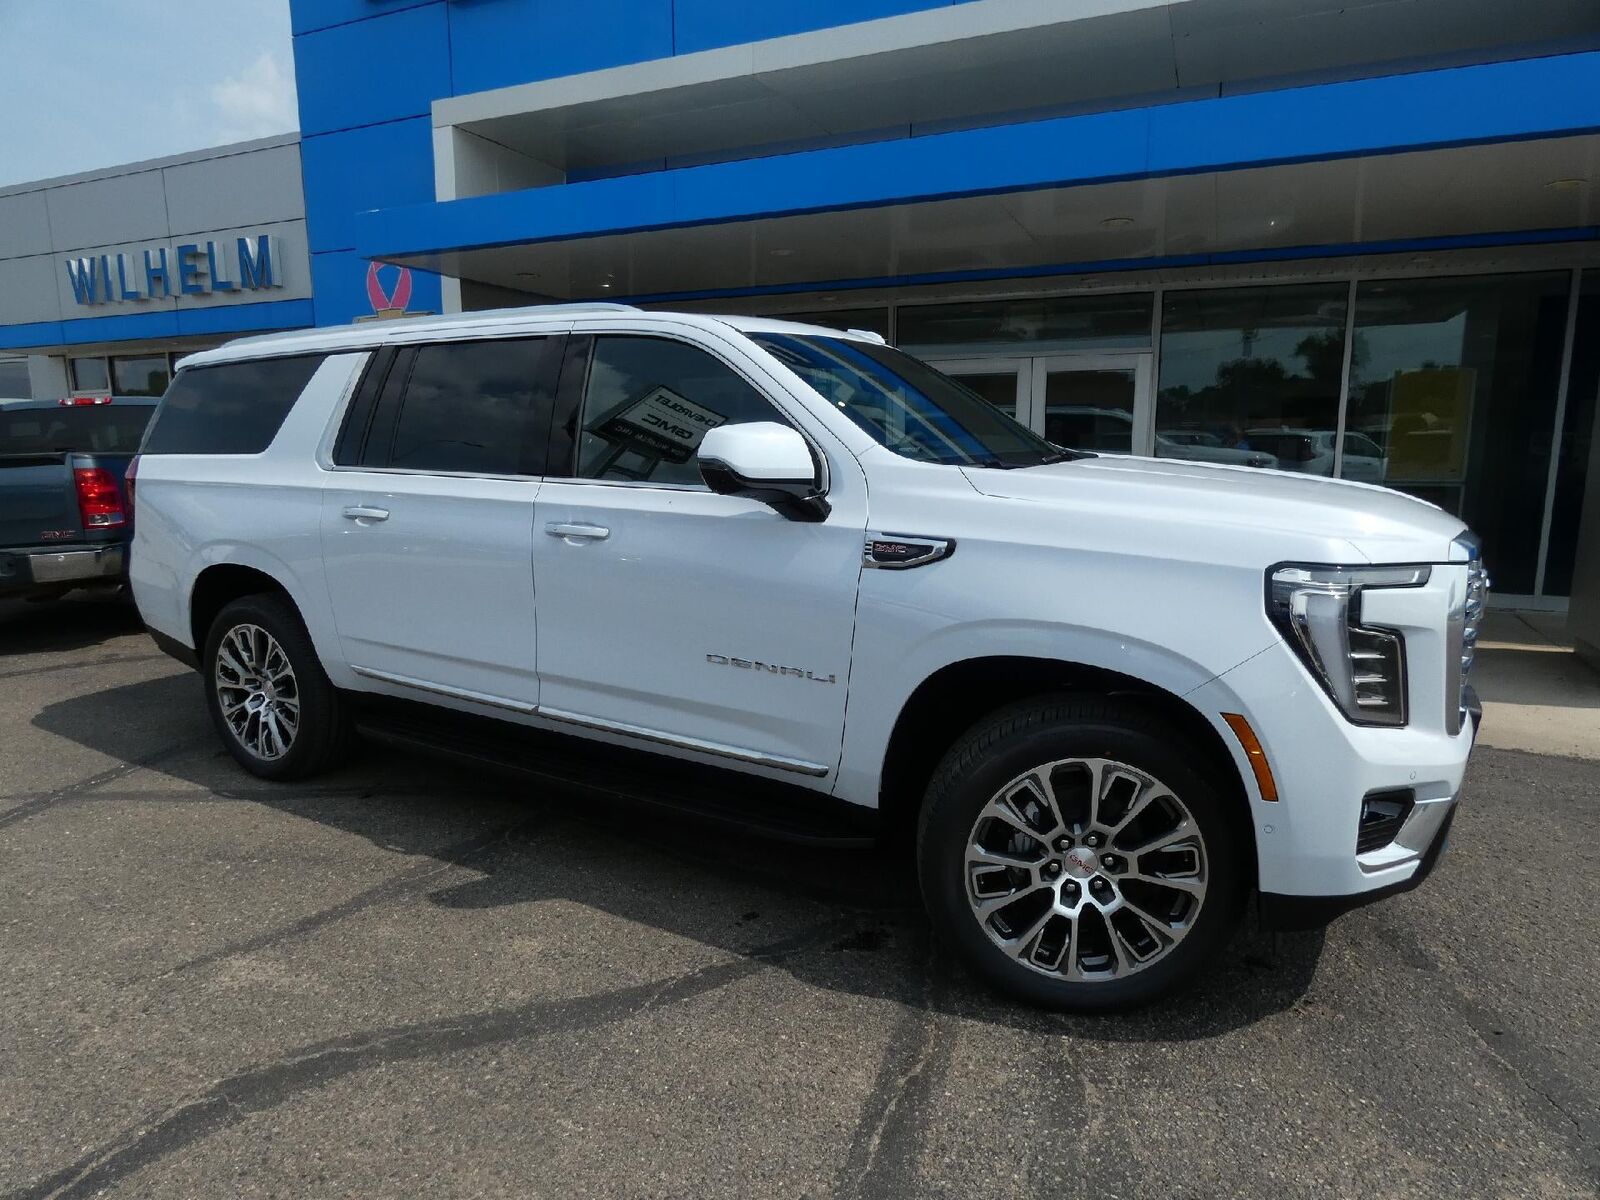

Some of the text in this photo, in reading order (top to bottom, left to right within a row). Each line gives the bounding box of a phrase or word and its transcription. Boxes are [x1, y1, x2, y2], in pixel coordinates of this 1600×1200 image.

[65, 235, 275, 305] WILHELM
[874, 543, 907, 553] GMC
[706, 653, 836, 684] DENALI
[1069, 854, 1094, 874] GMC
